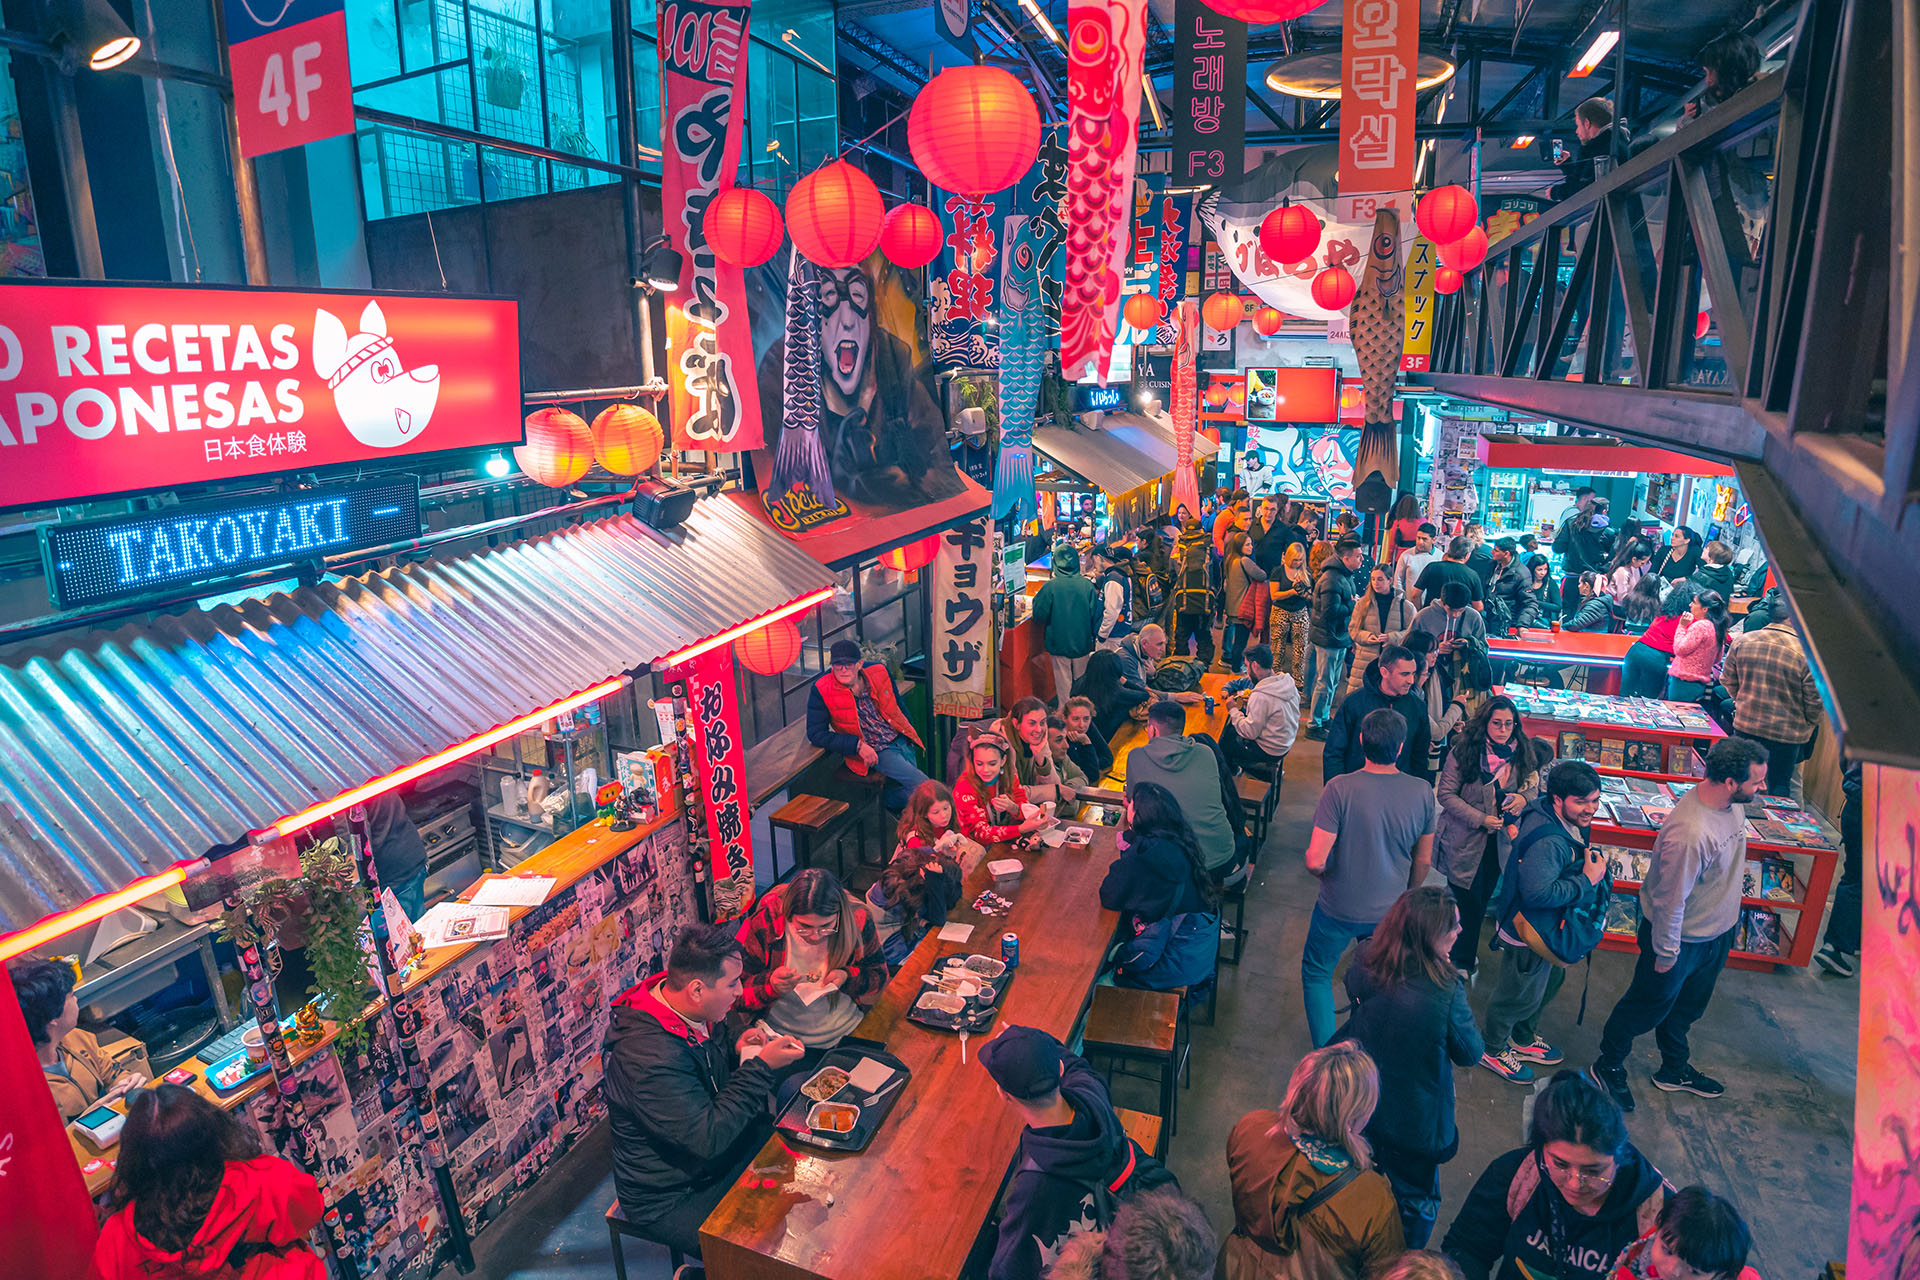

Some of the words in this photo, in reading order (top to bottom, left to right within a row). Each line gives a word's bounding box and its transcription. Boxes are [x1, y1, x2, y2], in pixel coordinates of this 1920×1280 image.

[259, 40, 323, 127] 4F
[1190, 15, 1226, 134] 노래방
[1188, 150, 1224, 178] F3
[1351, 198, 1376, 218] F3
[1410, 243, 1429, 340] スナック
[51, 323, 300, 379] RECETAS
[1406, 357, 1424, 369] 3F
[204, 430, 308, 463] 日本食体験
[108, 498, 349, 584] TAKOYAKI
[942, 519, 986, 683] ギョウザ
